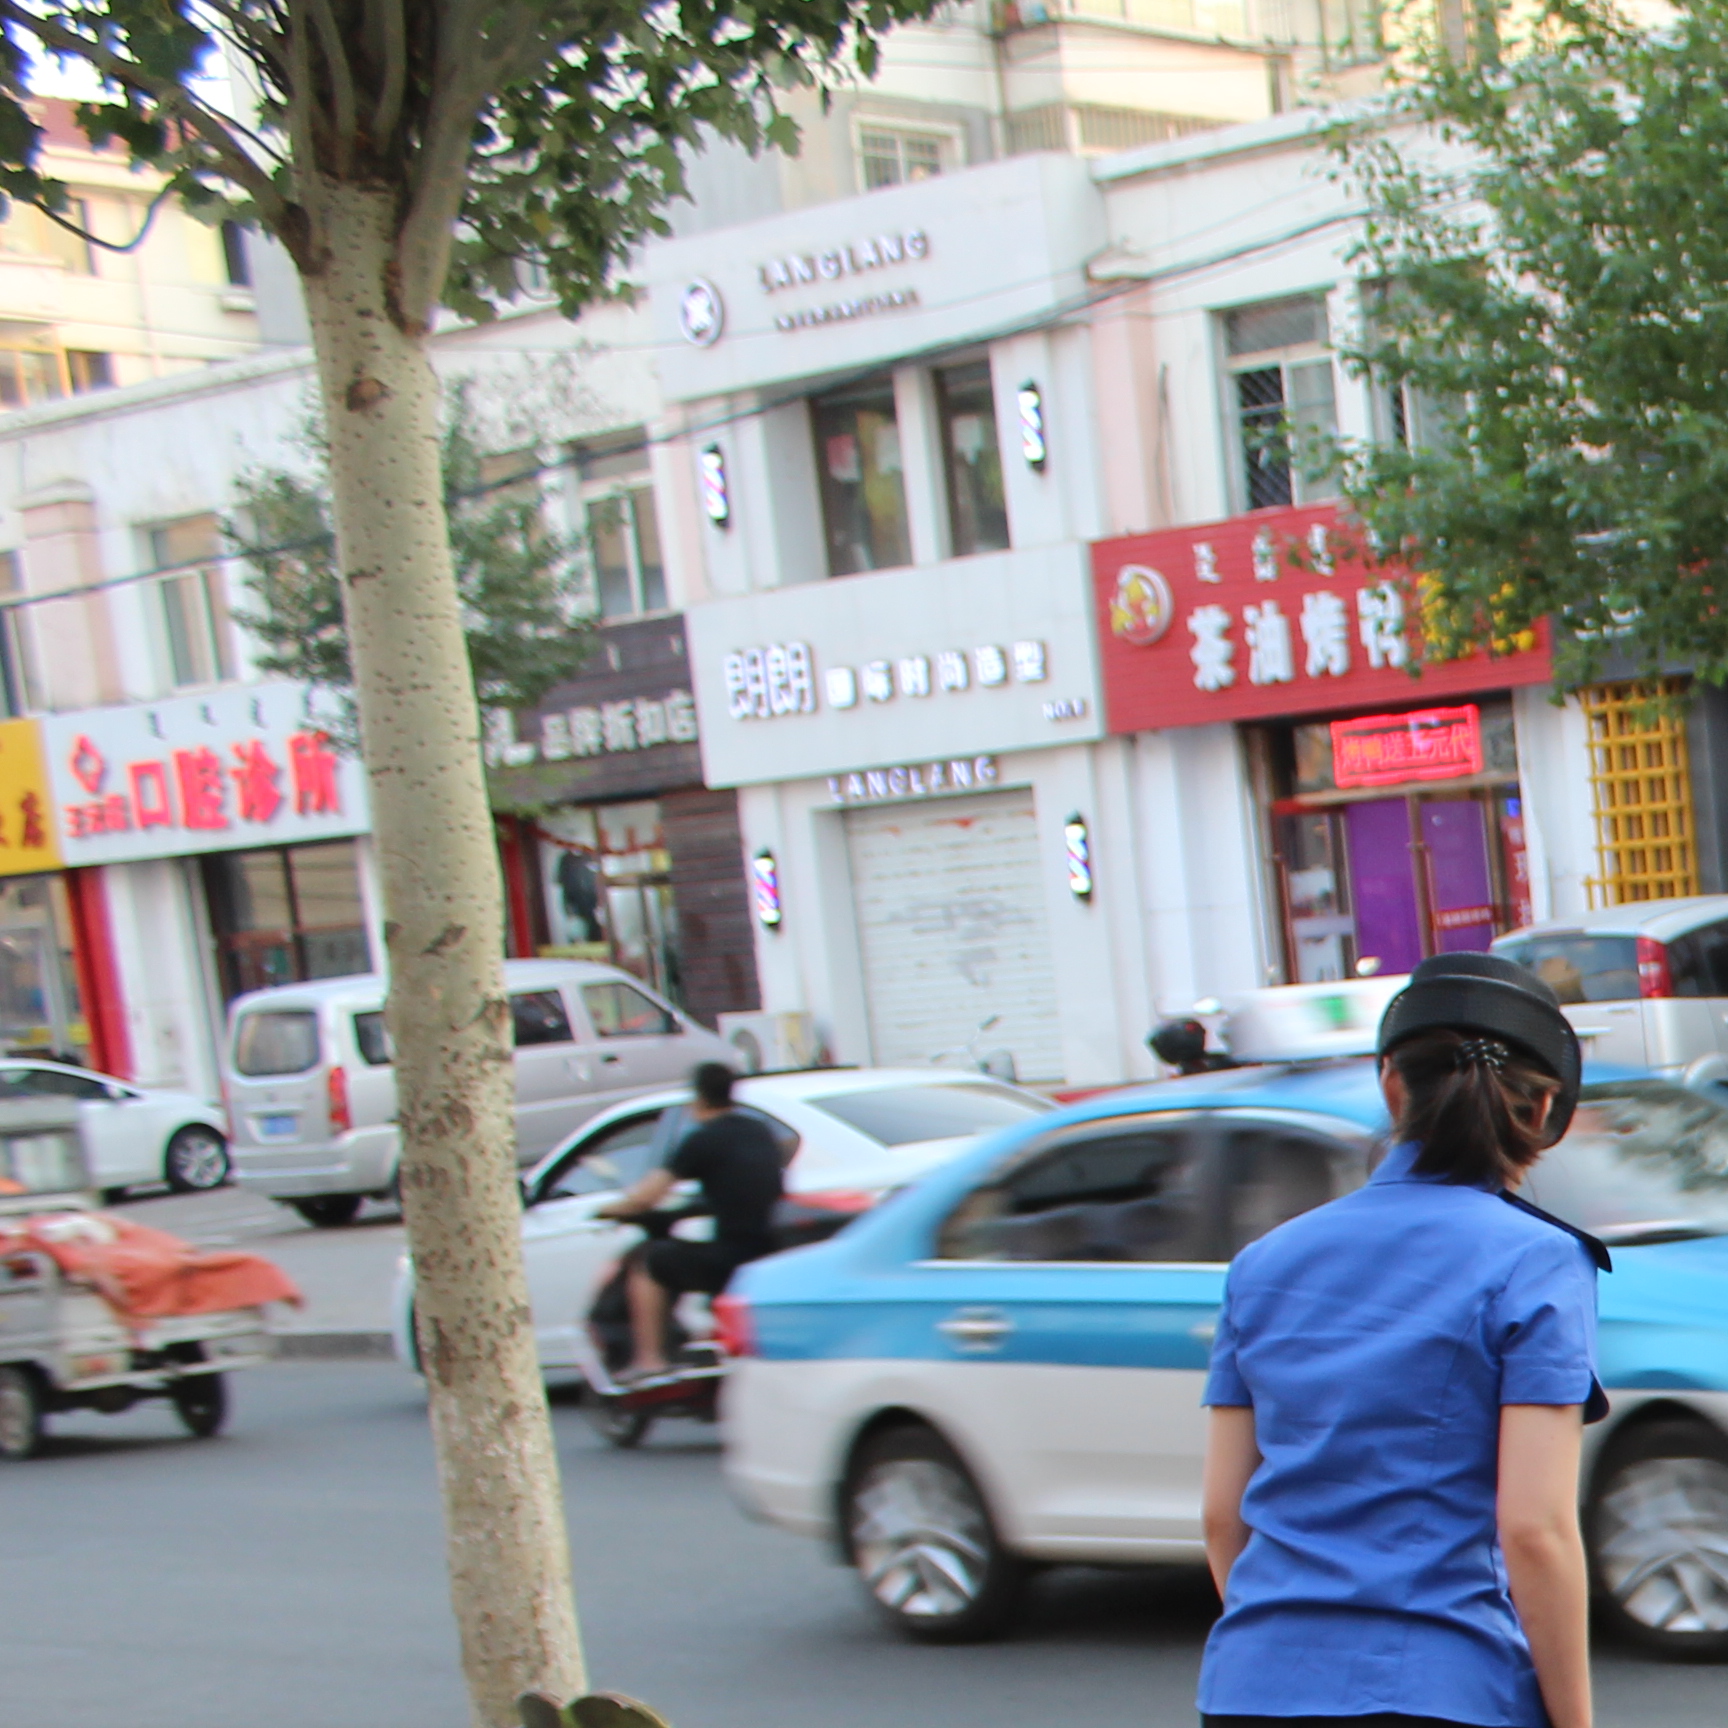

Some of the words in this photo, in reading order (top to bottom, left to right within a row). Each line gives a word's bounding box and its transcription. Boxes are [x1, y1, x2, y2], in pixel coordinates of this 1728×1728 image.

[758, 227, 931, 294] LANGLANG
[724, 641, 818, 721] 朗朗
[825, 640, 1046, 709] 国际时尚造型
[541, 687, 698, 762] 品牌折扣店
[126, 728, 341, 831] 口腔诊所
[827, 755, 998, 803] LANGLANG
